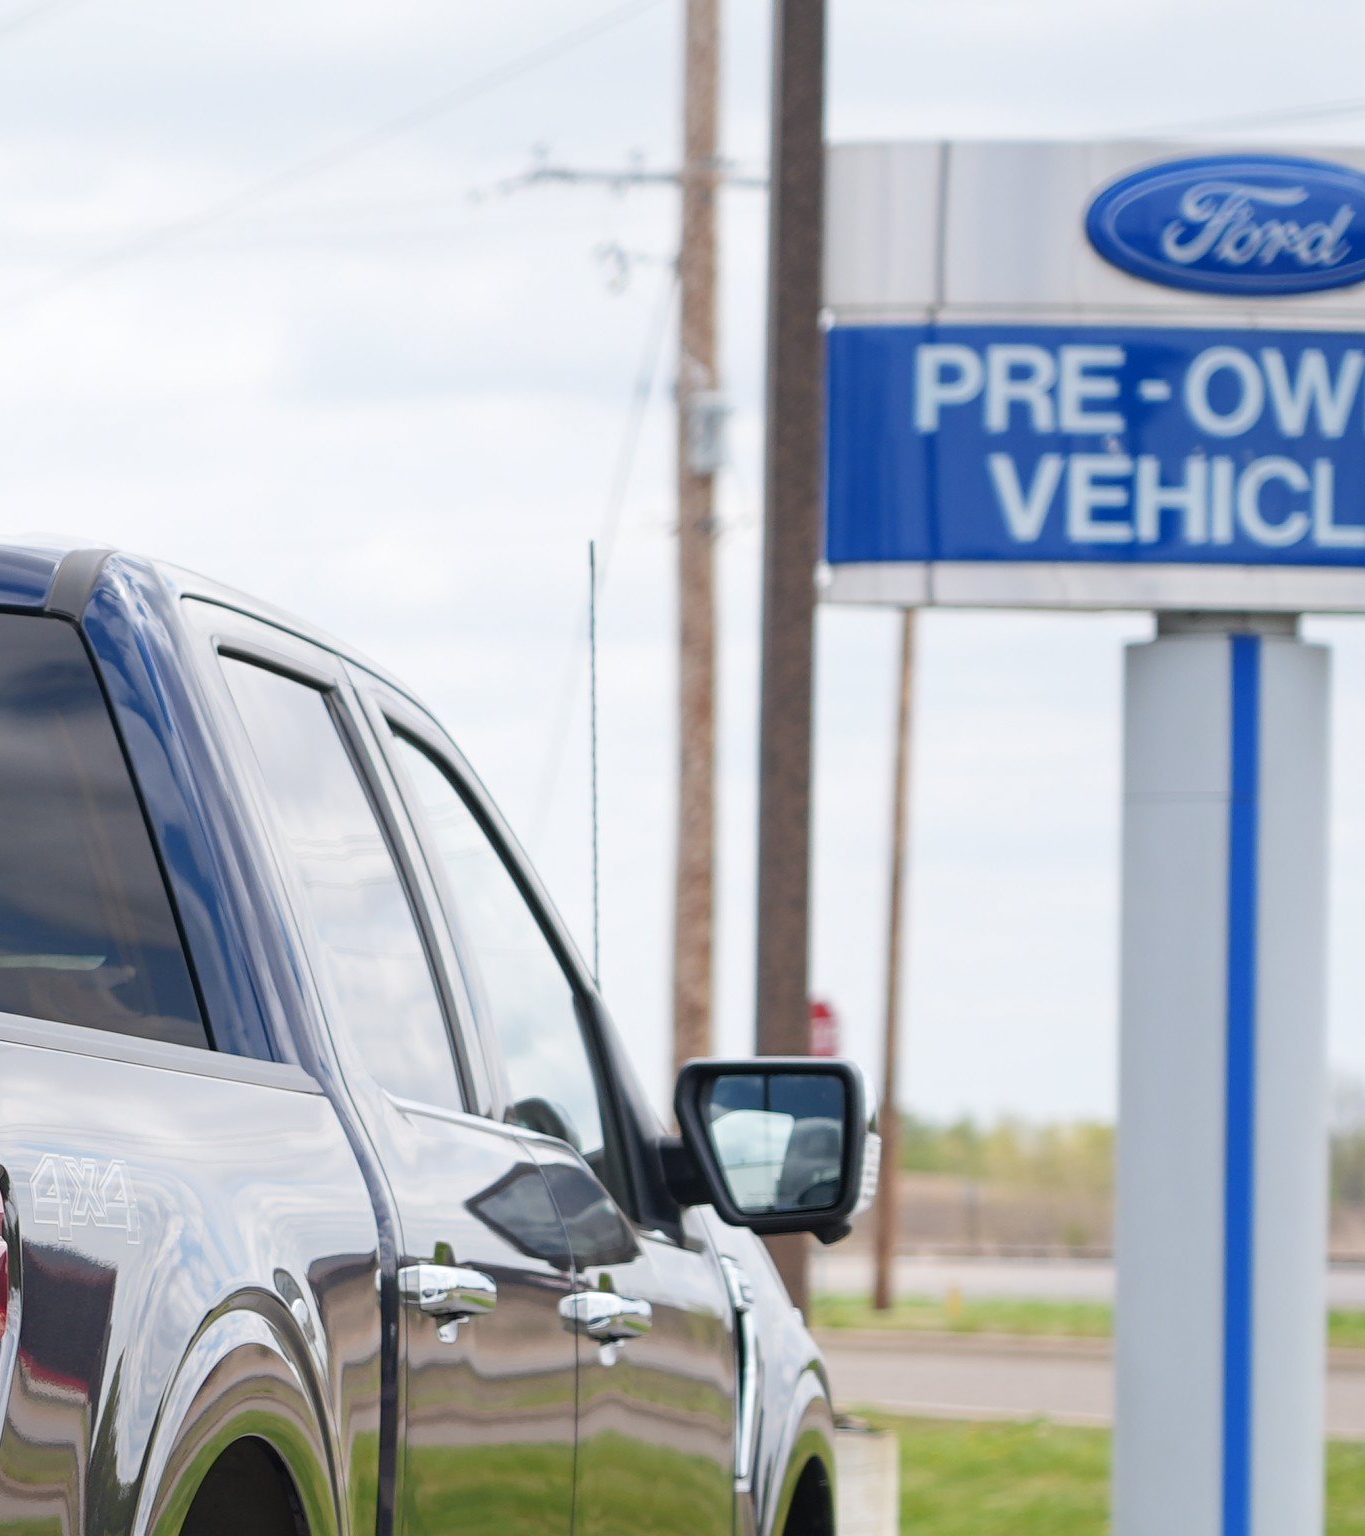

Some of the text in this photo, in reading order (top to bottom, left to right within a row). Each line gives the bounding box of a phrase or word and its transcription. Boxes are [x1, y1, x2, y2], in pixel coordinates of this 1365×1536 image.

[1161, 179, 1356, 267] Ford
[912, 342, 1365, 439] PRE-OW
[986, 451, 1365, 549] VEHICL
